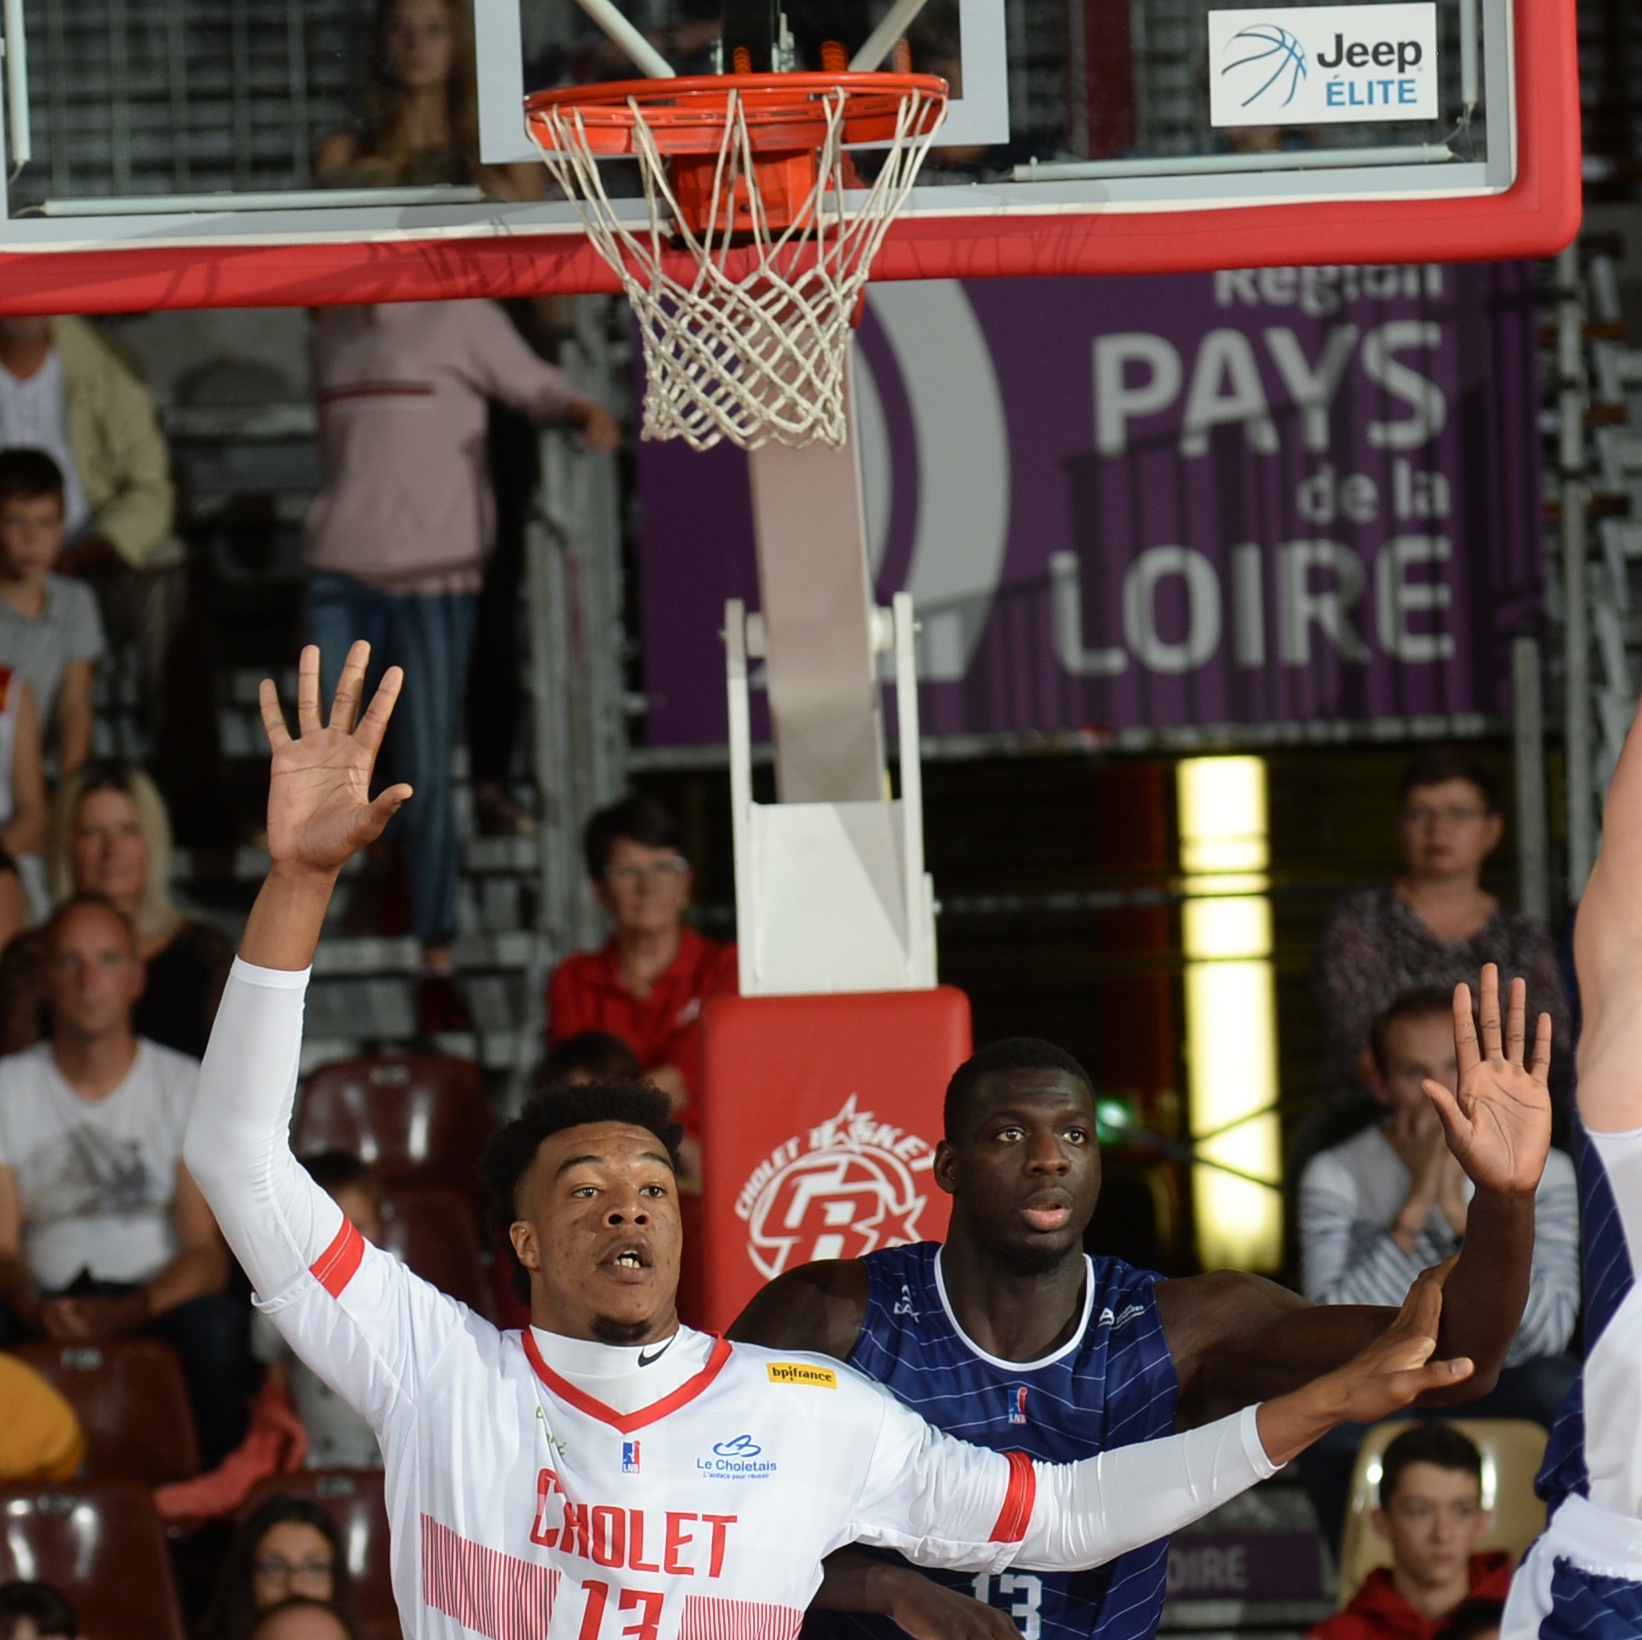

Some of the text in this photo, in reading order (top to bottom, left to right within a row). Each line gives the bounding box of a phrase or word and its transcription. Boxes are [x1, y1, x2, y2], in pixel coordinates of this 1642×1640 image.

[1316, 33, 1423, 73] Jeep
[1326, 75, 1418, 106] ÉLITE
[1091, 319, 1447, 458] PAYS
[1295, 456, 1451, 525] de la
[1050, 534, 1455, 677] LOIRE
[734, 1136, 801, 1221] CHOLET
[771, 1365, 833, 1384] bpifrance
[696, 1457, 778, 1472] Le Choletais
[529, 1467, 738, 1579] CHOLET
